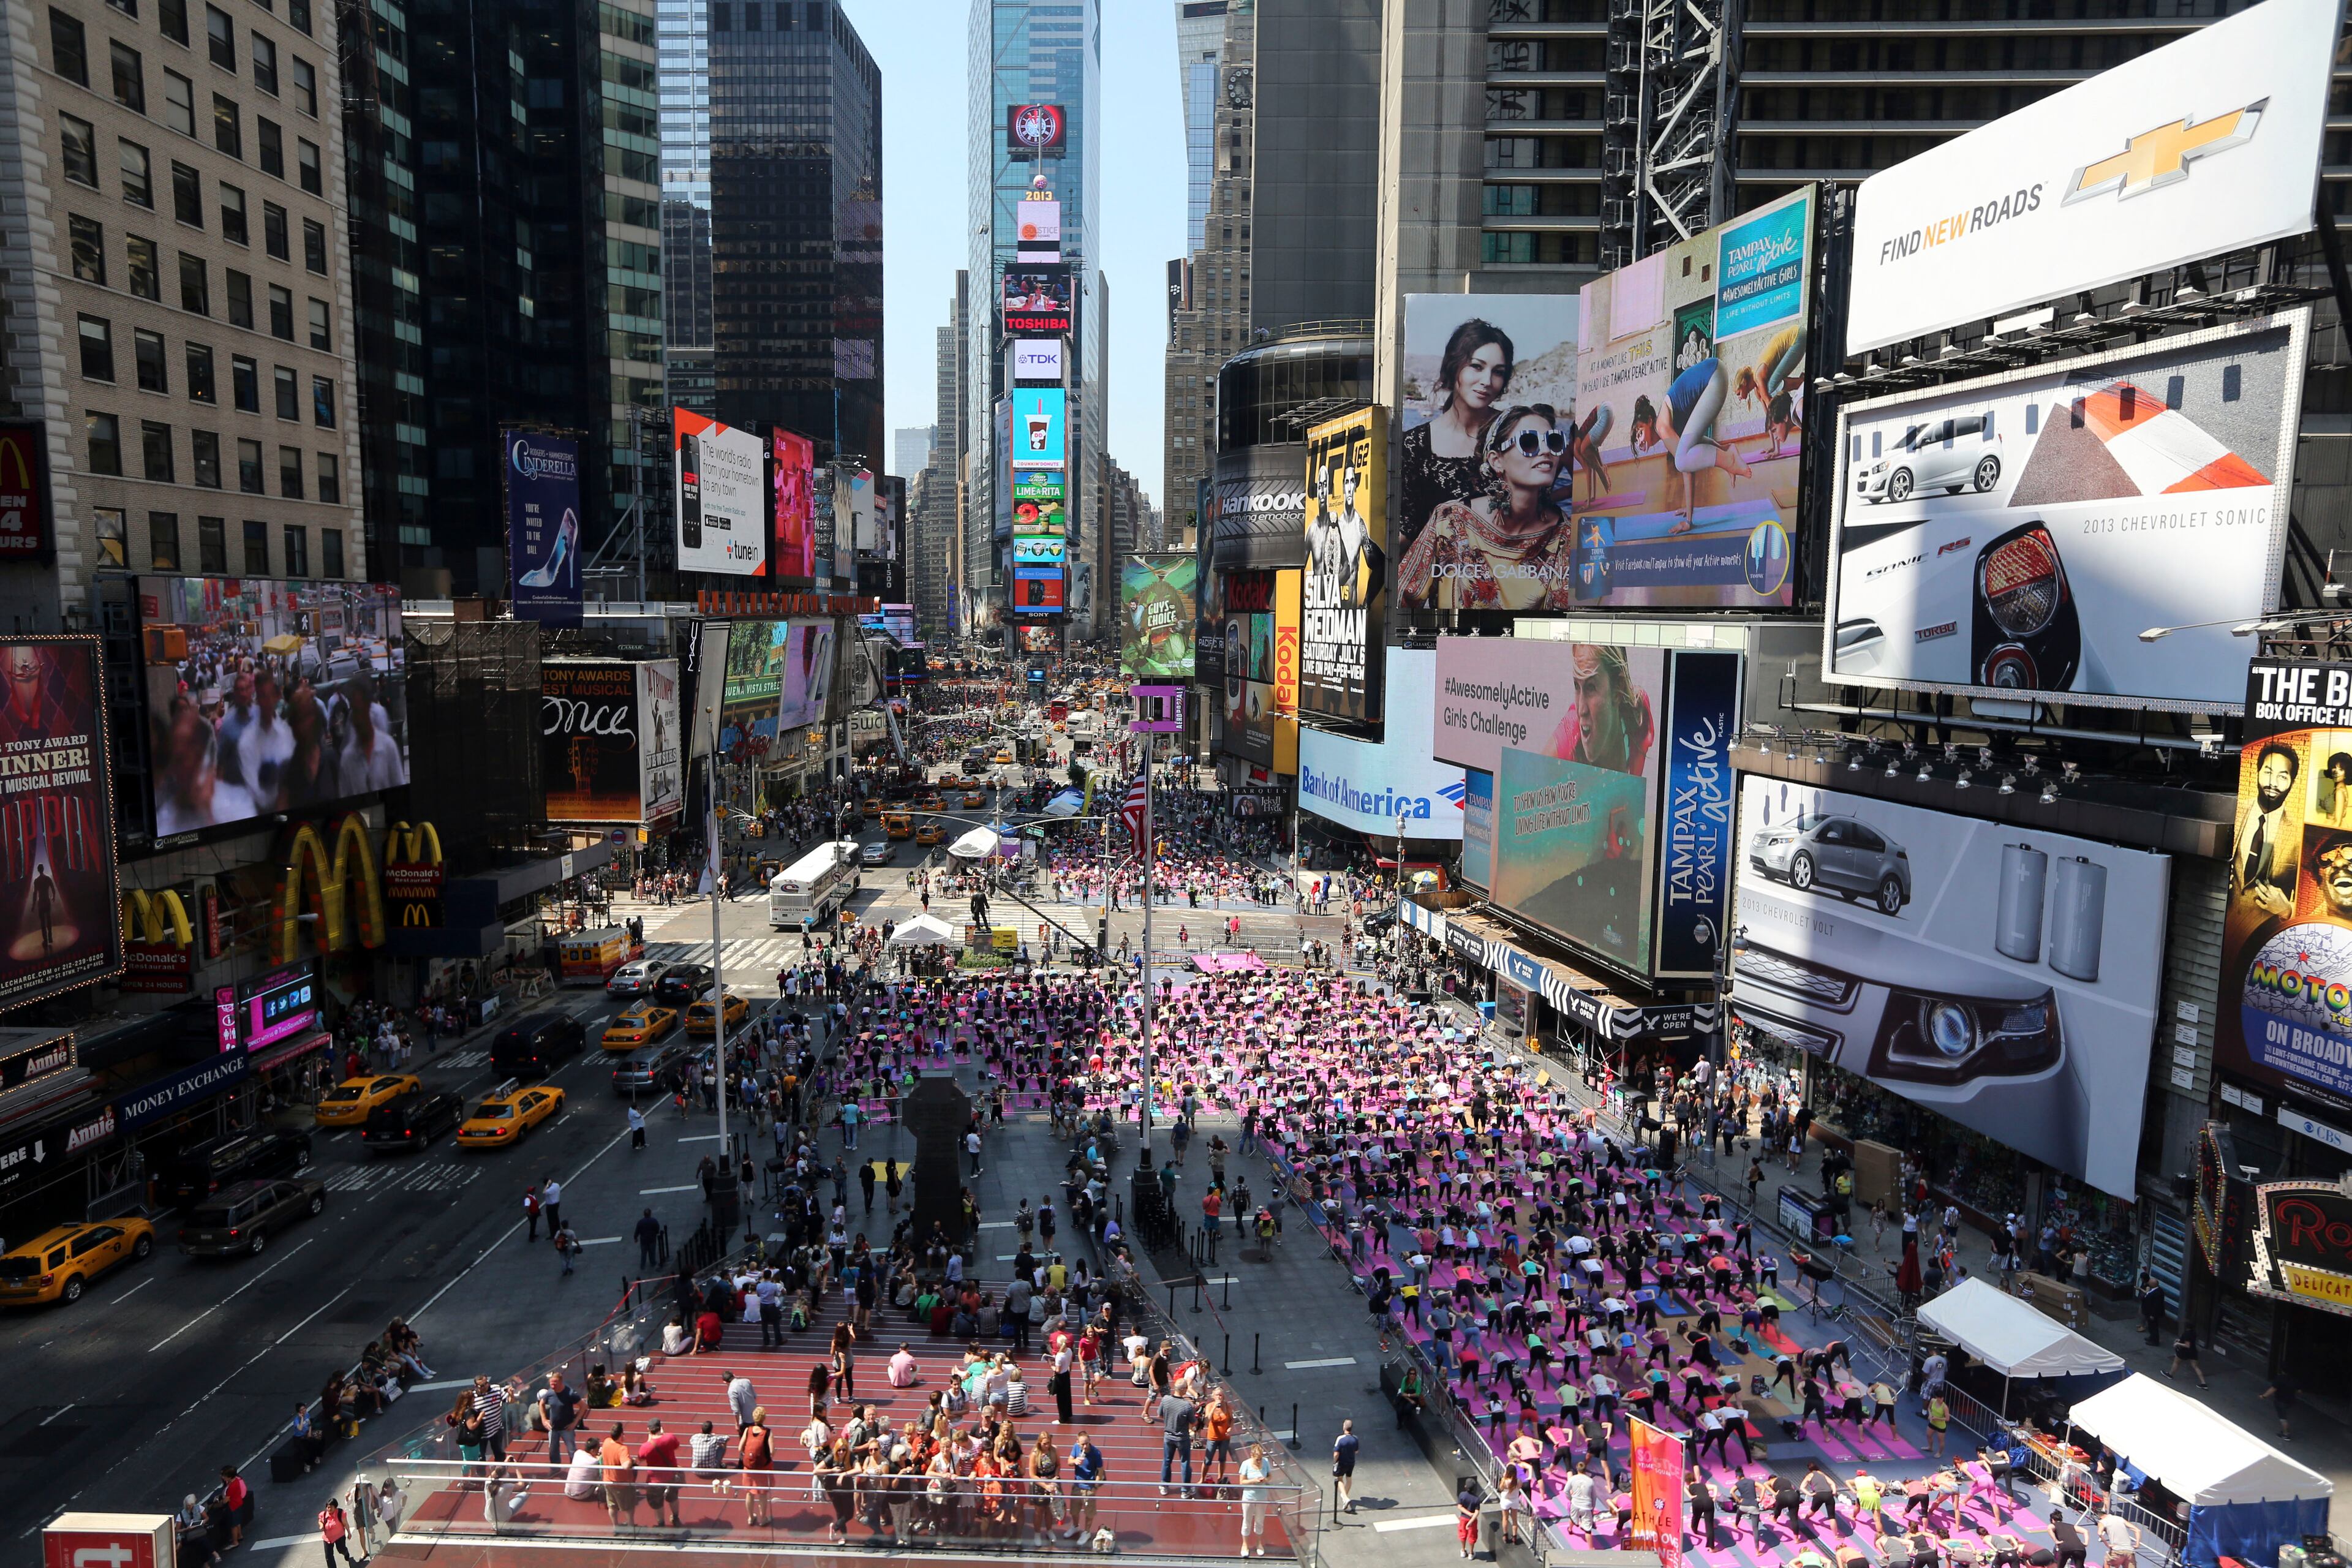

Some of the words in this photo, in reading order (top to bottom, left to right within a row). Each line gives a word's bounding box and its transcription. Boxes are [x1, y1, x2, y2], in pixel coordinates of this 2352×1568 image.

[1026, 191, 1052, 201] 2013
[1880, 230, 1921, 266] FIND
[1923, 210, 1970, 250] NEW
[1970, 183, 2043, 233] ROADS
[1728, 235, 1771, 265] TAMPAX
[1779, 265, 1798, 284] GIRLS
[1726, 309, 1739, 318] LIFE
[1740, 299, 1768, 314] WITHOUT
[1770, 292, 1792, 305] LIMITS
[1006, 318, 1069, 329] TOSHIBA
[1027, 355, 1058, 364] TDK
[1600, 355, 1618, 371] MOMENT
[1618, 352, 1627, 366] LIKE
[1629, 339, 1653, 363] THIS
[1588, 377, 1599, 393] GLAD
[1611, 368, 1630, 385] TAMPAX
[1649, 357, 1667, 374] ACTIVE
[703, 440, 714, 458] The
[715, 447, 736, 466] world's
[737, 453, 752, 469] radio
[1355, 442, 1370, 468] 162
[703, 459, 717, 475] from
[718, 466, 731, 480] your
[732, 467, 760, 487] hometown
[703, 477, 710, 491] to
[711, 483, 722, 496] any
[722, 481, 737, 497] town
[526, 503, 540, 513] YOU'RE
[1230, 514, 1257, 522] driving
[1257, 511, 1305, 521] emotion
[526, 517, 543, 527] INVITED
[2084, 518, 2114, 533] 2013
[2121, 511, 2207, 532] CHEVROLET
[2215, 508, 2266, 526] SONIC
[527, 531, 532, 540] TO
[527, 545, 537, 554] BALL
[734, 540, 759, 561] tunein
[1615, 559, 1625, 571] Visit
[1668, 558, 1673, 568] to
[1673, 556, 1686, 568] show
[1693, 556, 1703, 570] your
[1704, 555, 1720, 567] Active
[1721, 552, 1742, 565] moments
[1864, 552, 1929, 583] SONIC
[1937, 537, 1972, 558] RS
[1431, 564, 1483, 578] DOLCE
[1483, 570, 1490, 579] &
[1229, 574, 1270, 609] Kodak
[1305, 571, 1341, 608] SILVA
[1340, 586, 1349, 601] VS
[1148, 600, 1169, 615] GUYS
[1147, 610, 1176, 627] CHOICE
[1304, 609, 1366, 645] WEIDMAN
[1917, 623, 1956, 639] TURBO
[1199, 638, 1217, 648] PACIFIC
[1303, 642, 1338, 662] SATURDAY
[1339, 645, 1359, 664] JULY
[1359, 646, 1366, 665] 6
[543, 670, 576, 681] TONY
[576, 671, 631, 681] AWARDS
[1276, 627, 1297, 722] Kodak
[1302, 660, 1315, 674] LIVE
[1315, 662, 1324, 675] ON
[1324, 662, 1365, 680] PAY-PER-VIEW
[572, 684, 632, 696] MUSICAL
[747, 683, 763, 694] VISTA
[1445, 677, 1550, 710] #AwesomelyActive
[2255, 702, 2284, 721] BOX
[2285, 704, 2335, 725] OFFICE
[1444, 707, 1468, 729] Girls
[1470, 711, 1527, 745] Challenge
[5, 739, 42, 753] TONY
[43, 734, 89, 748] AWARD
[6, 774, 51, 794] MUSICAL
[53, 769, 92, 787] REVIVAL
[1303, 765, 1329, 800] Bank
[1329, 776, 1340, 804] of
[1340, 778, 1431, 820] America
[1514, 796, 1520, 813] TO
[1521, 791, 1536, 812] SHOW
[1537, 789, 1544, 809] US
[1544, 786, 1556, 806] HOW
[1558, 782, 1577, 802] YOU'RE
[1515, 816, 1533, 836] LIVING
[1534, 812, 1545, 832] LIFE
[1546, 807, 1570, 828] WITHOUT
[1571, 802, 1590, 824] LIMITS
[1669, 786, 1698, 907] TAMPAX
[386, 869, 440, 878] McDonald's
[1743, 897, 1760, 913] 2013
[1763, 903, 1809, 929] CHEVROLET
[1813, 919, 1834, 937] VOLT
[1453, 929, 1464, 941] WE'RE
[1453, 937, 1463, 948] OPEN
[1470, 938, 1483, 951] WE'RE
[1469, 946, 1480, 957] OPEN
[62, 952, 104, 971] 212-239-6200
[128, 962, 176, 970] Restaurant
[1522, 963, 1533, 974] WE'RE
[1521, 969, 1531, 979] OPEN
[1579, 1008, 1594, 1022] OPEN
[1580, 998, 1596, 1014] WE'RE
[1662, 1020, 1687, 1030] OPEN
[1663, 1012, 1691, 1022] WE'RE
[2266, 1019, 2288, 1046] ON
[24, 1046, 69, 1078] Annie
[124, 1087, 175, 1121] MONEY
[177, 1056, 244, 1097] EXCHANGE
[2312, 1086, 2328, 1098] FROM
[65, 1115, 116, 1153] Annie
[2316, 1126, 2342, 1147] CBS
